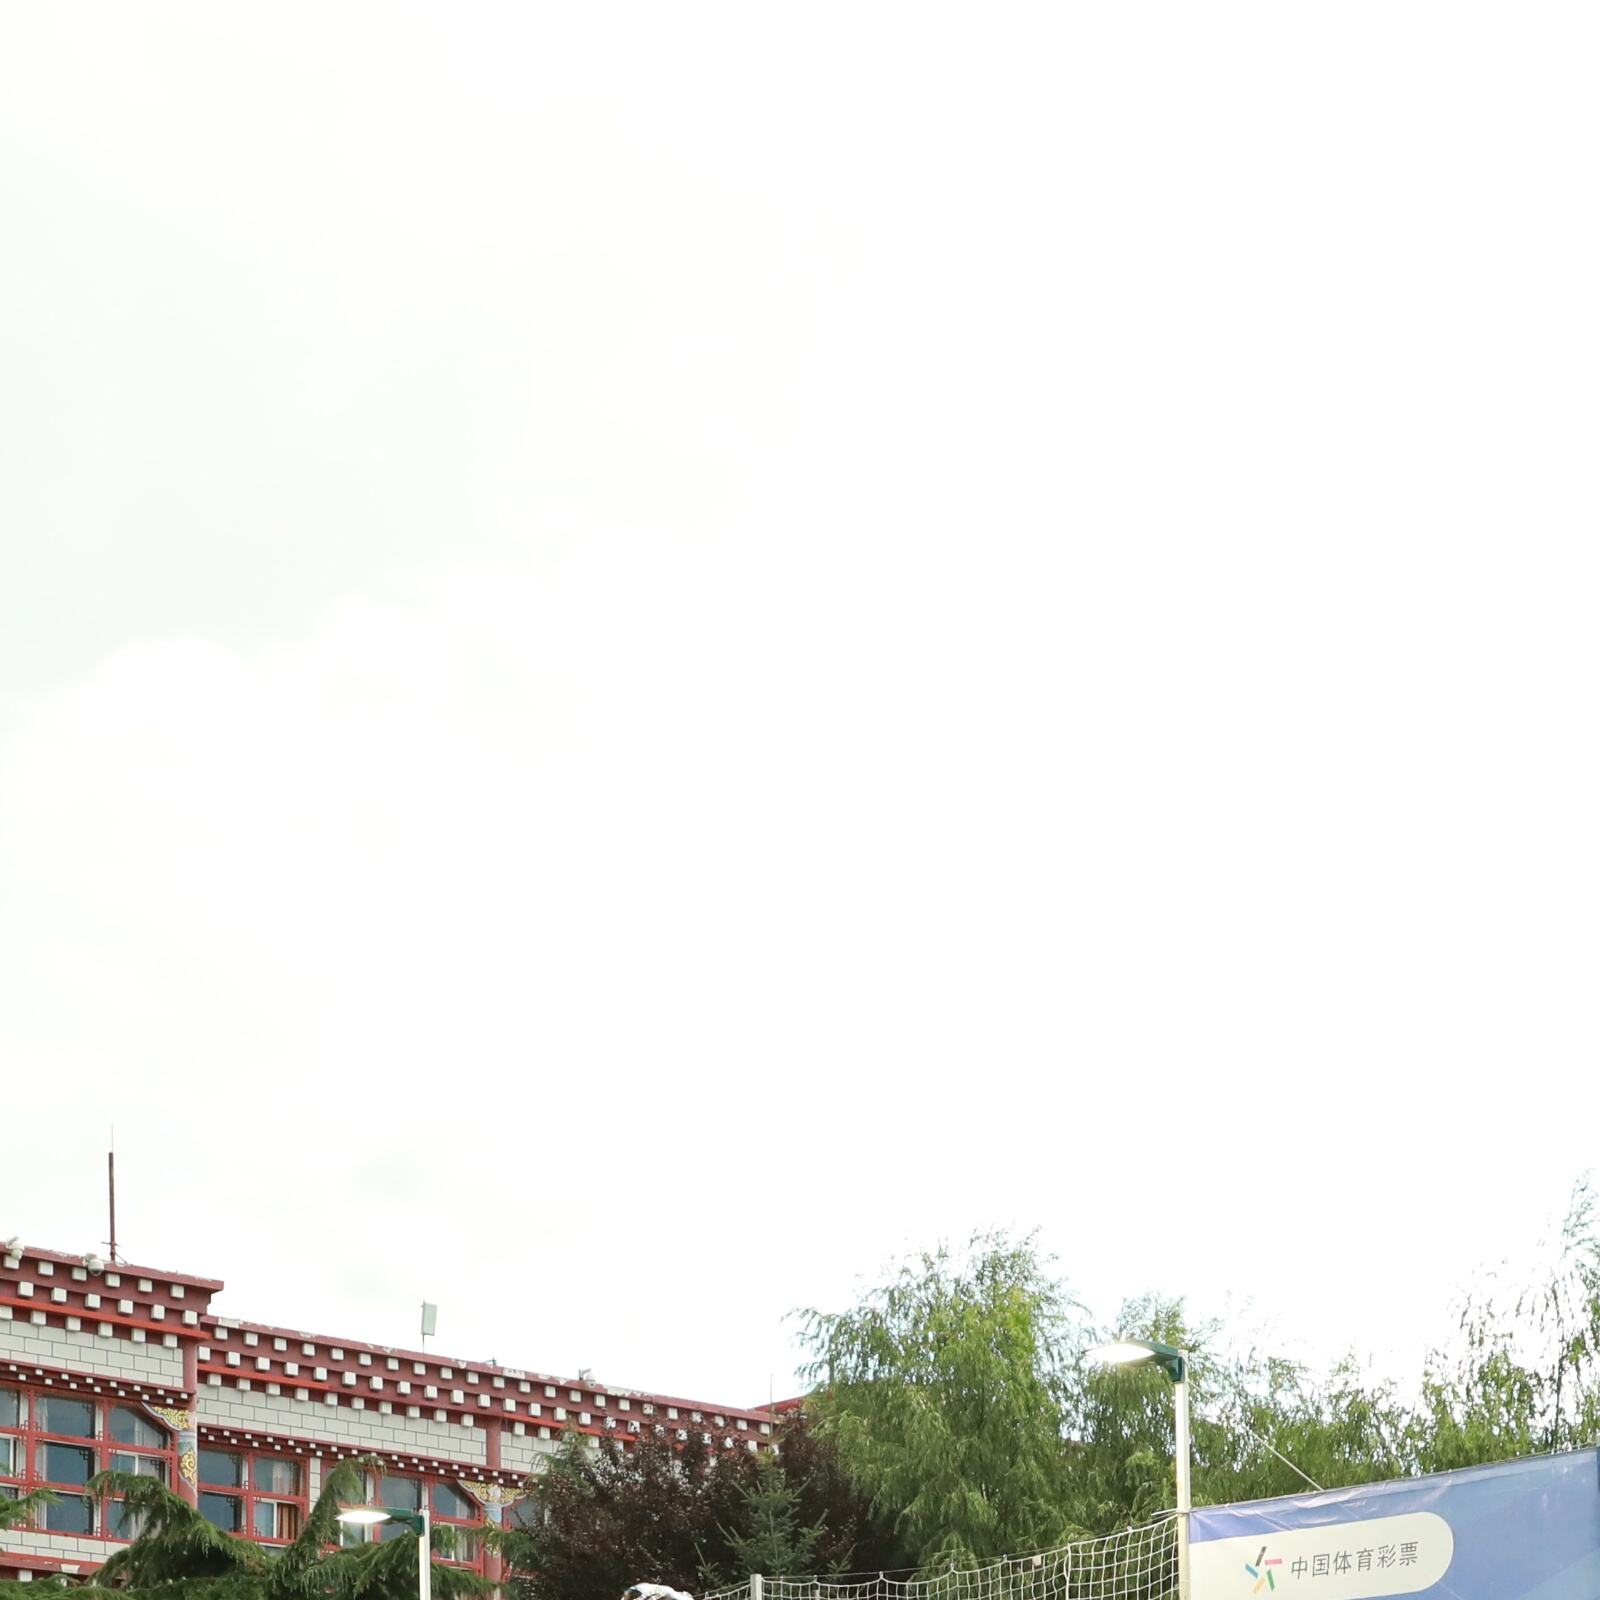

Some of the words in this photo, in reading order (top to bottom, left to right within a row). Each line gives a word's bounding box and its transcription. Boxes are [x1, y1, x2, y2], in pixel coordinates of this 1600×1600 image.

[1290, 1541, 1419, 1580] 中国体育彩票
